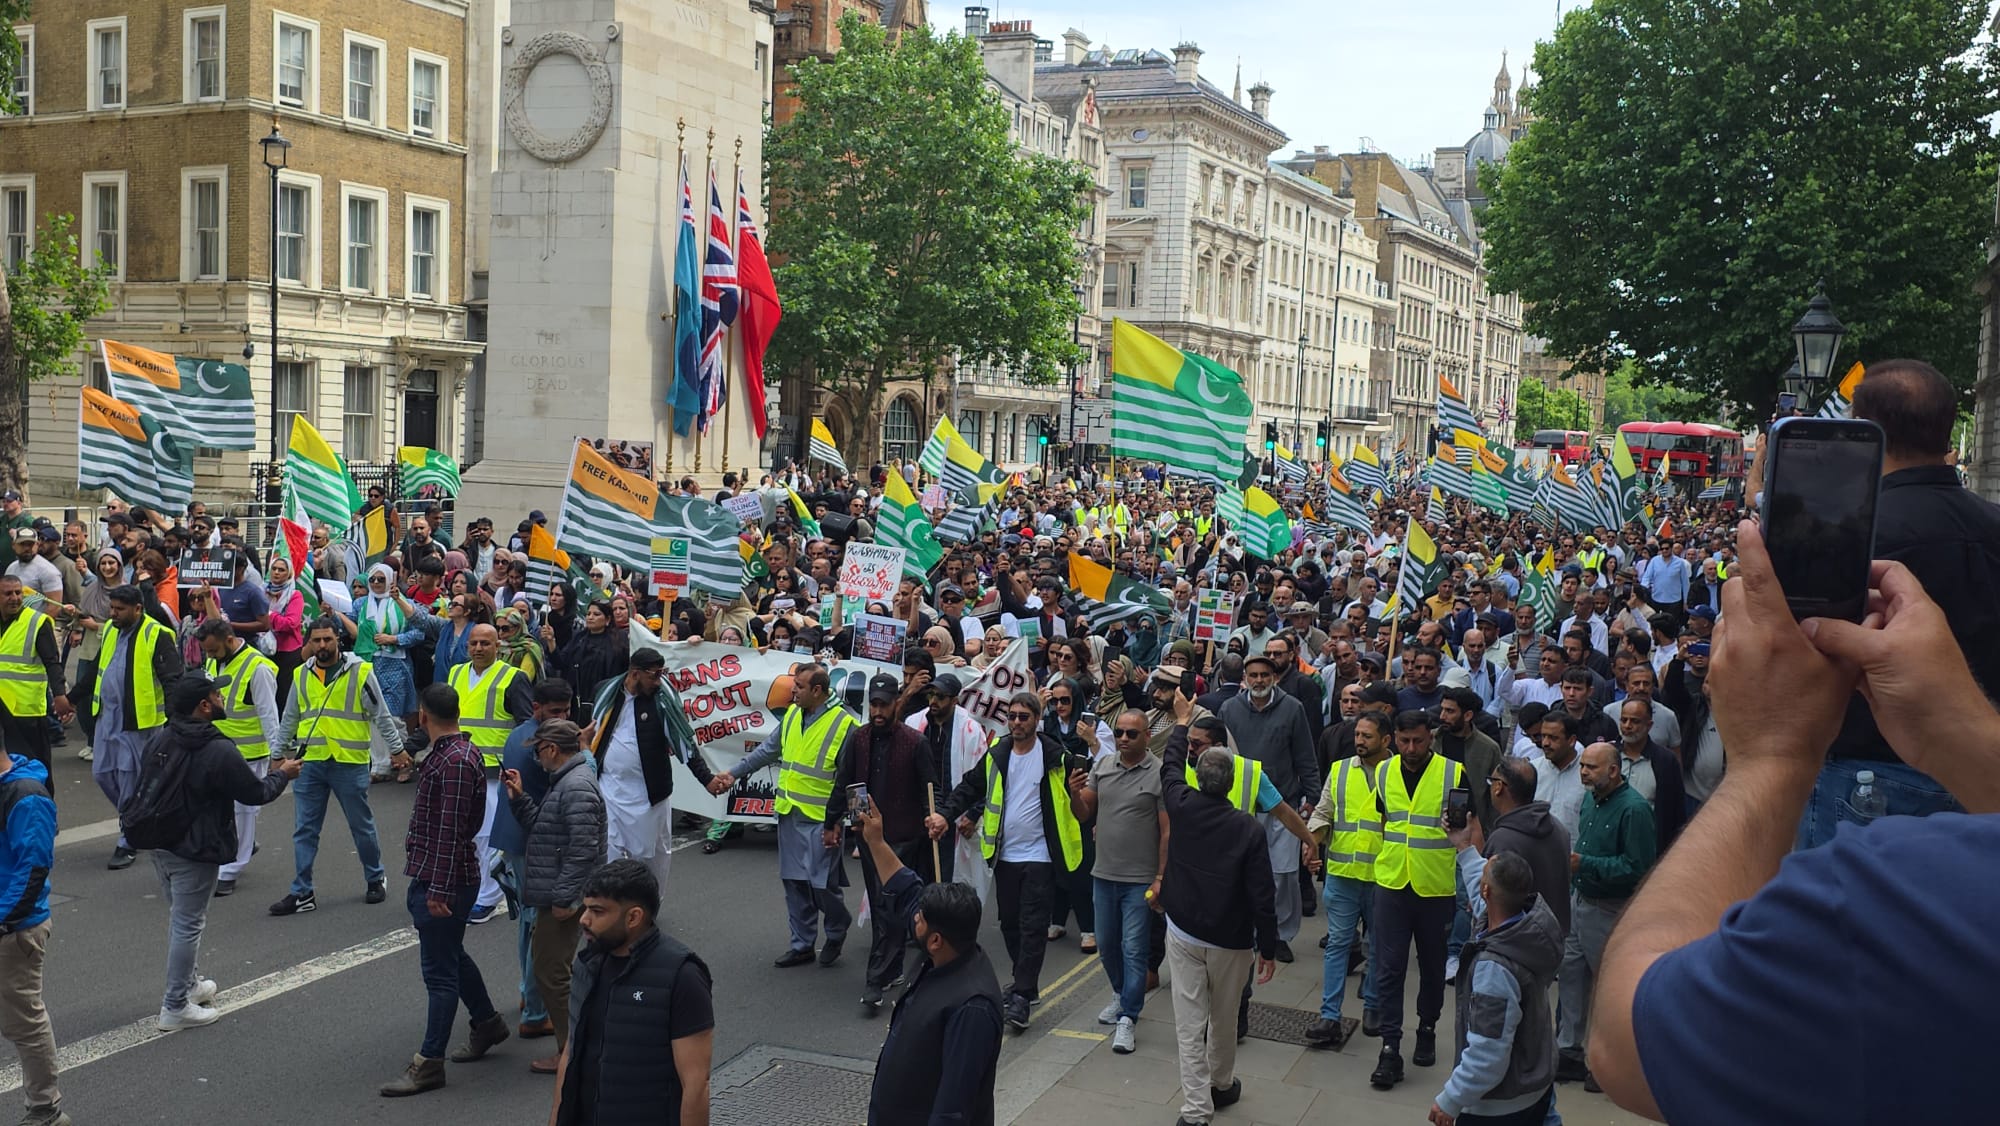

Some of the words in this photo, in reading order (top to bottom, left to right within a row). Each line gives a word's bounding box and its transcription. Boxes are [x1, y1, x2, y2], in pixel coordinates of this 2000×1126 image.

[536, 332, 561, 345] THE
[511, 355, 585, 368] GLORIOUS
[527, 377, 568, 391] DEAD
[582, 461, 607, 480] FREE
[608, 475, 649, 505] KASIR
[182, 569, 211, 578] VIOLENCE
[212, 570, 230, 579] NOW
[961, 687, 1009, 726] THE
[695, 710, 765, 746] RIGHTS
